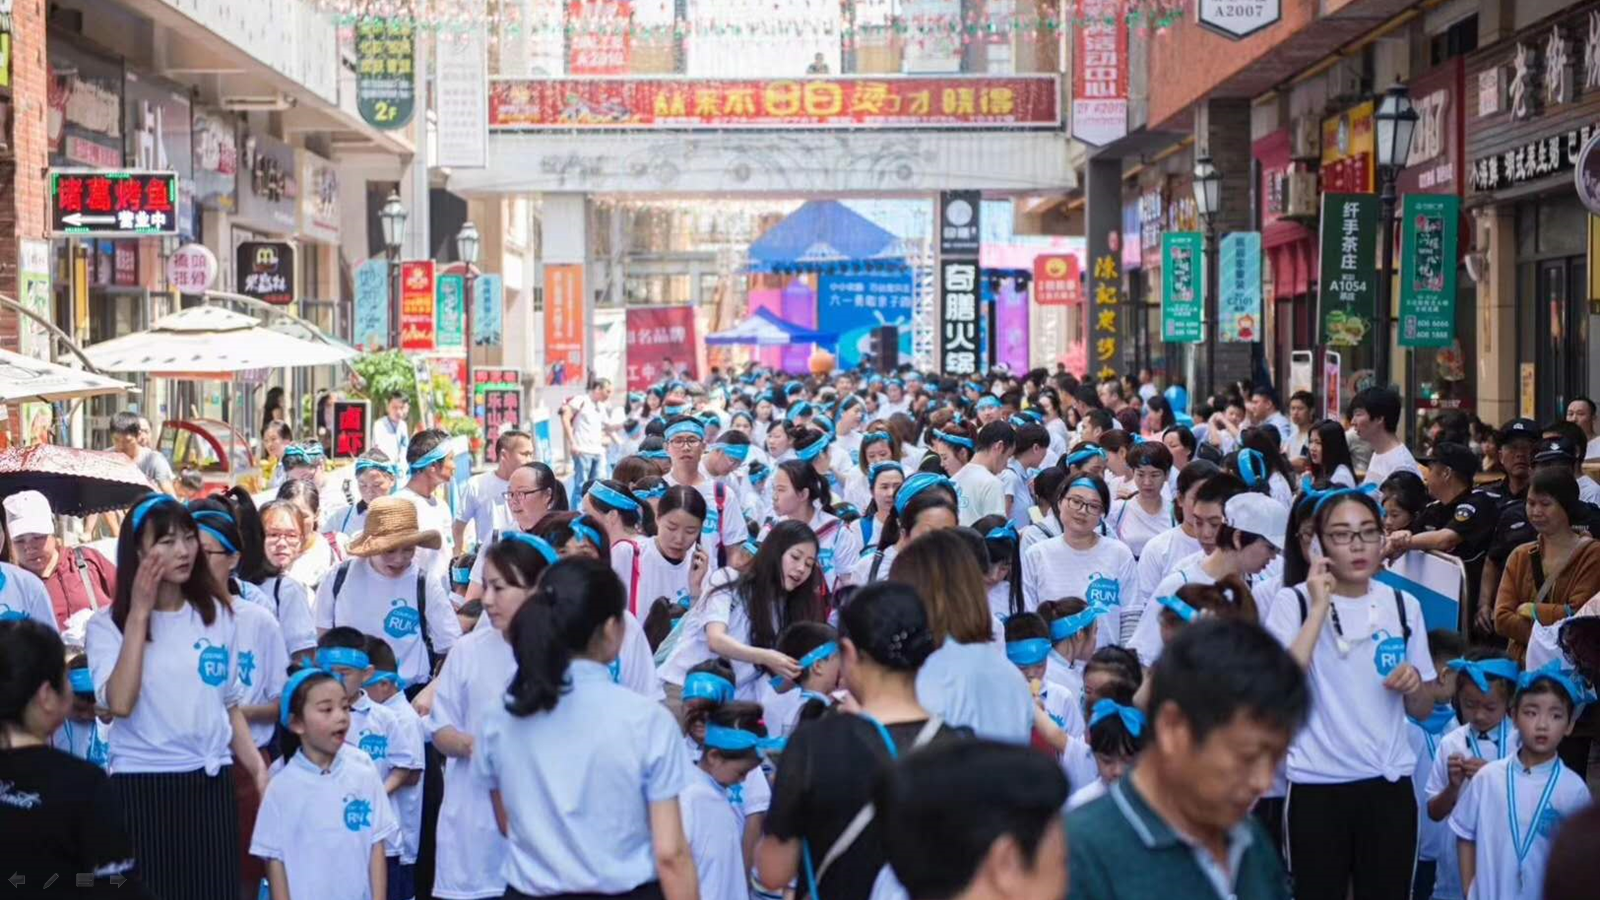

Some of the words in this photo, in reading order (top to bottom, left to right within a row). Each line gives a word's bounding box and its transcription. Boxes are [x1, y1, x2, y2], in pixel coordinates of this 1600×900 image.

[1214, 5, 1263, 17] A2007
[374, 101, 398, 122] 2F
[59, 176, 171, 211] 诸葛烤鱼
[118, 209, 166, 229] 营业中
[1341, 202, 1359, 270] 纤手茶庄
[1330, 281, 1366, 292] A1054
[945, 264, 976, 374] 奇膳火锅
[1091, 588, 1116, 601] RUN
[390, 616, 415, 631] RUN
